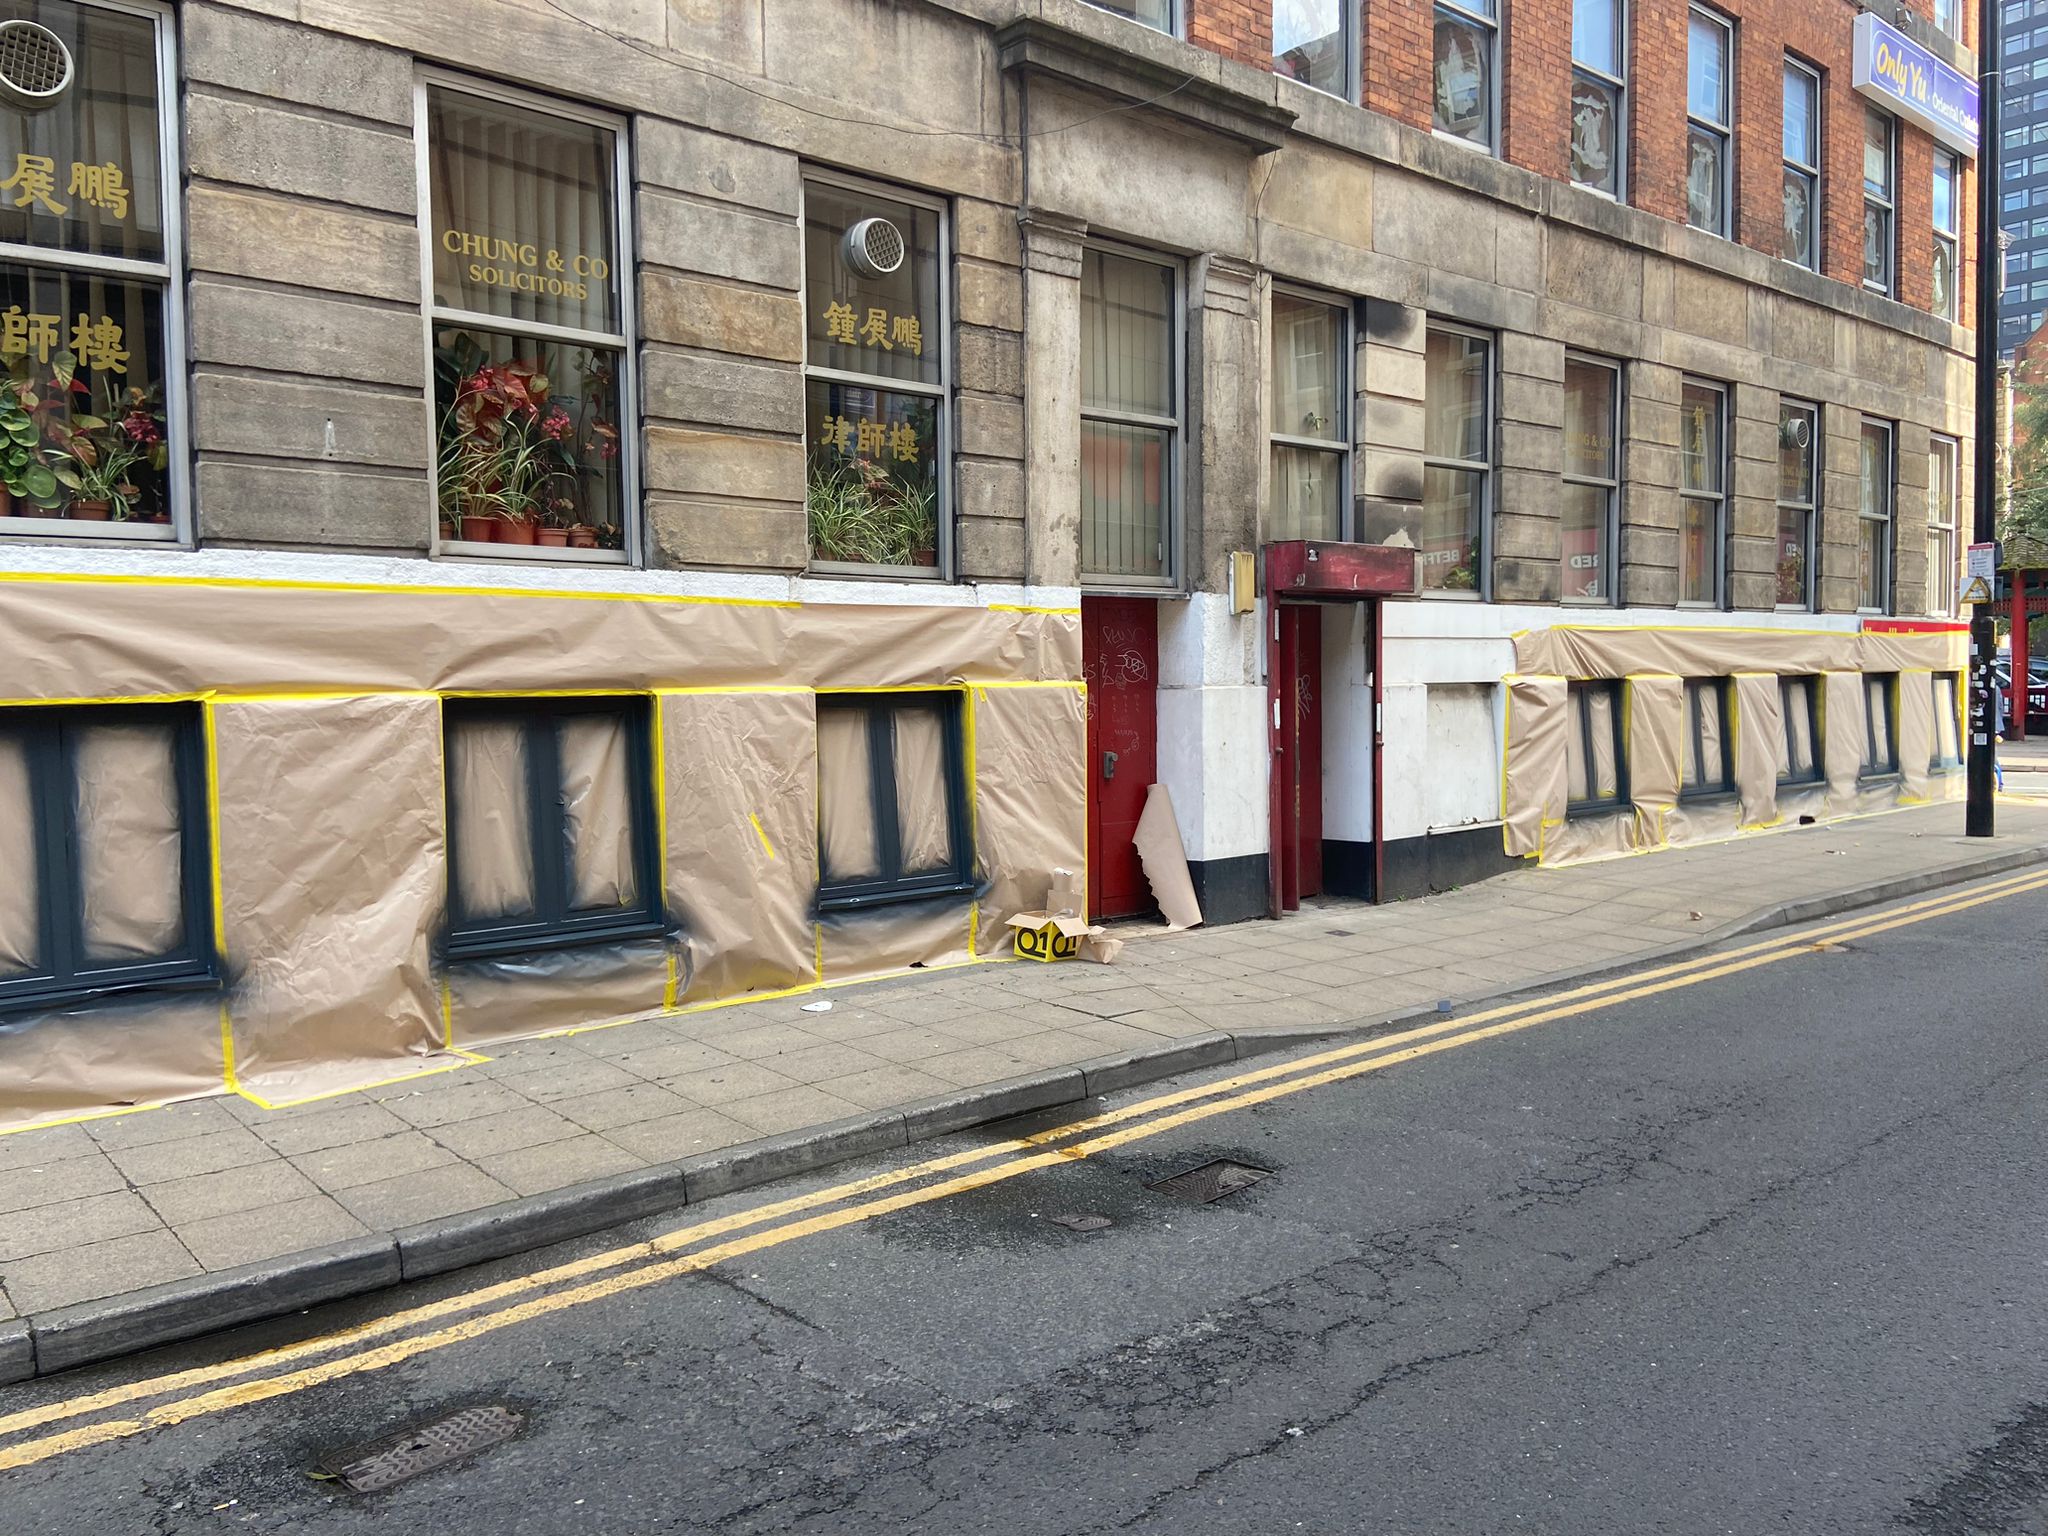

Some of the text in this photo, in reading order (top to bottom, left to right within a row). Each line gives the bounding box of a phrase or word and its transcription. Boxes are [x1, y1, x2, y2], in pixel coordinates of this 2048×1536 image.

[1876, 42, 1908, 98] Only
[1909, 61, 1927, 104] Yu
[1932, 91, 1959, 123] Oriental
[442, 229, 609, 280] CHUNG & CO
[469, 263, 588, 300] SOLICITORS
[1, 304, 131, 374] 師樓
[821, 415, 920, 463] 律師樓
